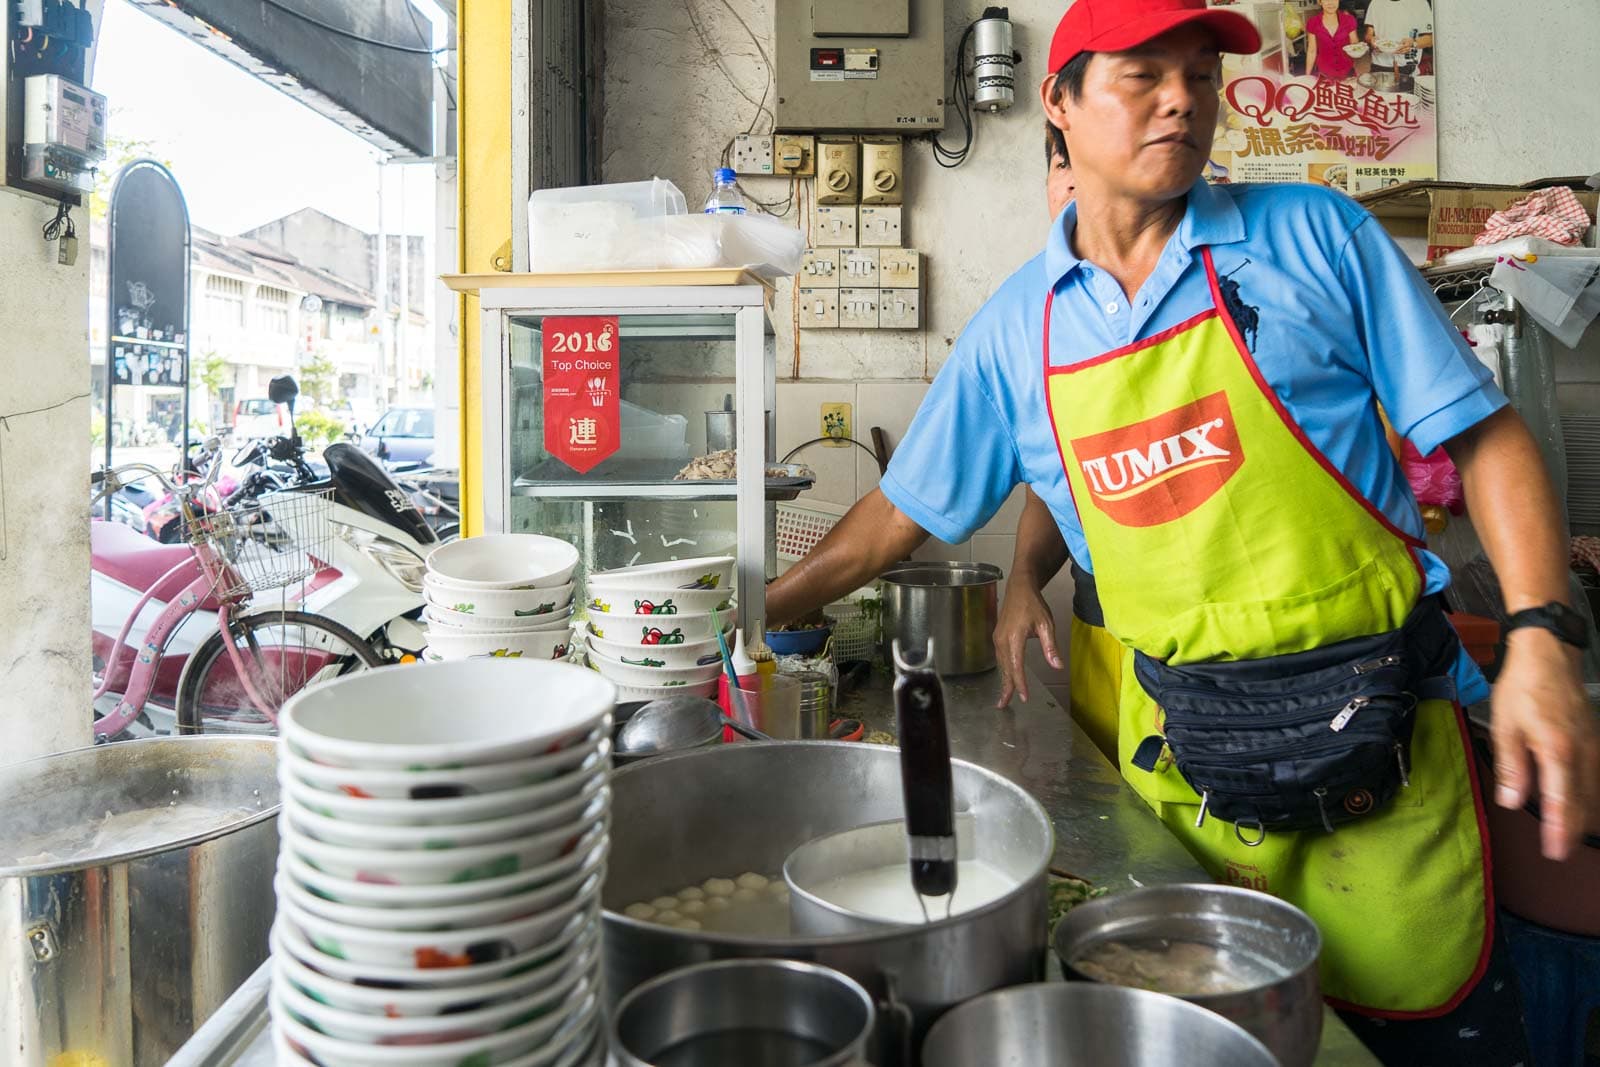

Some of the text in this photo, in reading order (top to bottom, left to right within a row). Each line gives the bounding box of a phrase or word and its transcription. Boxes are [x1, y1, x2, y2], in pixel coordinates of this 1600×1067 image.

[1226, 74, 1419, 128] QQ鳗鱼丸
[551, 331, 613, 353] 2016
[552, 359, 612, 372] Top Choice
[569, 417, 597, 445] 連
[1081, 418, 1231, 493] TUMIX
